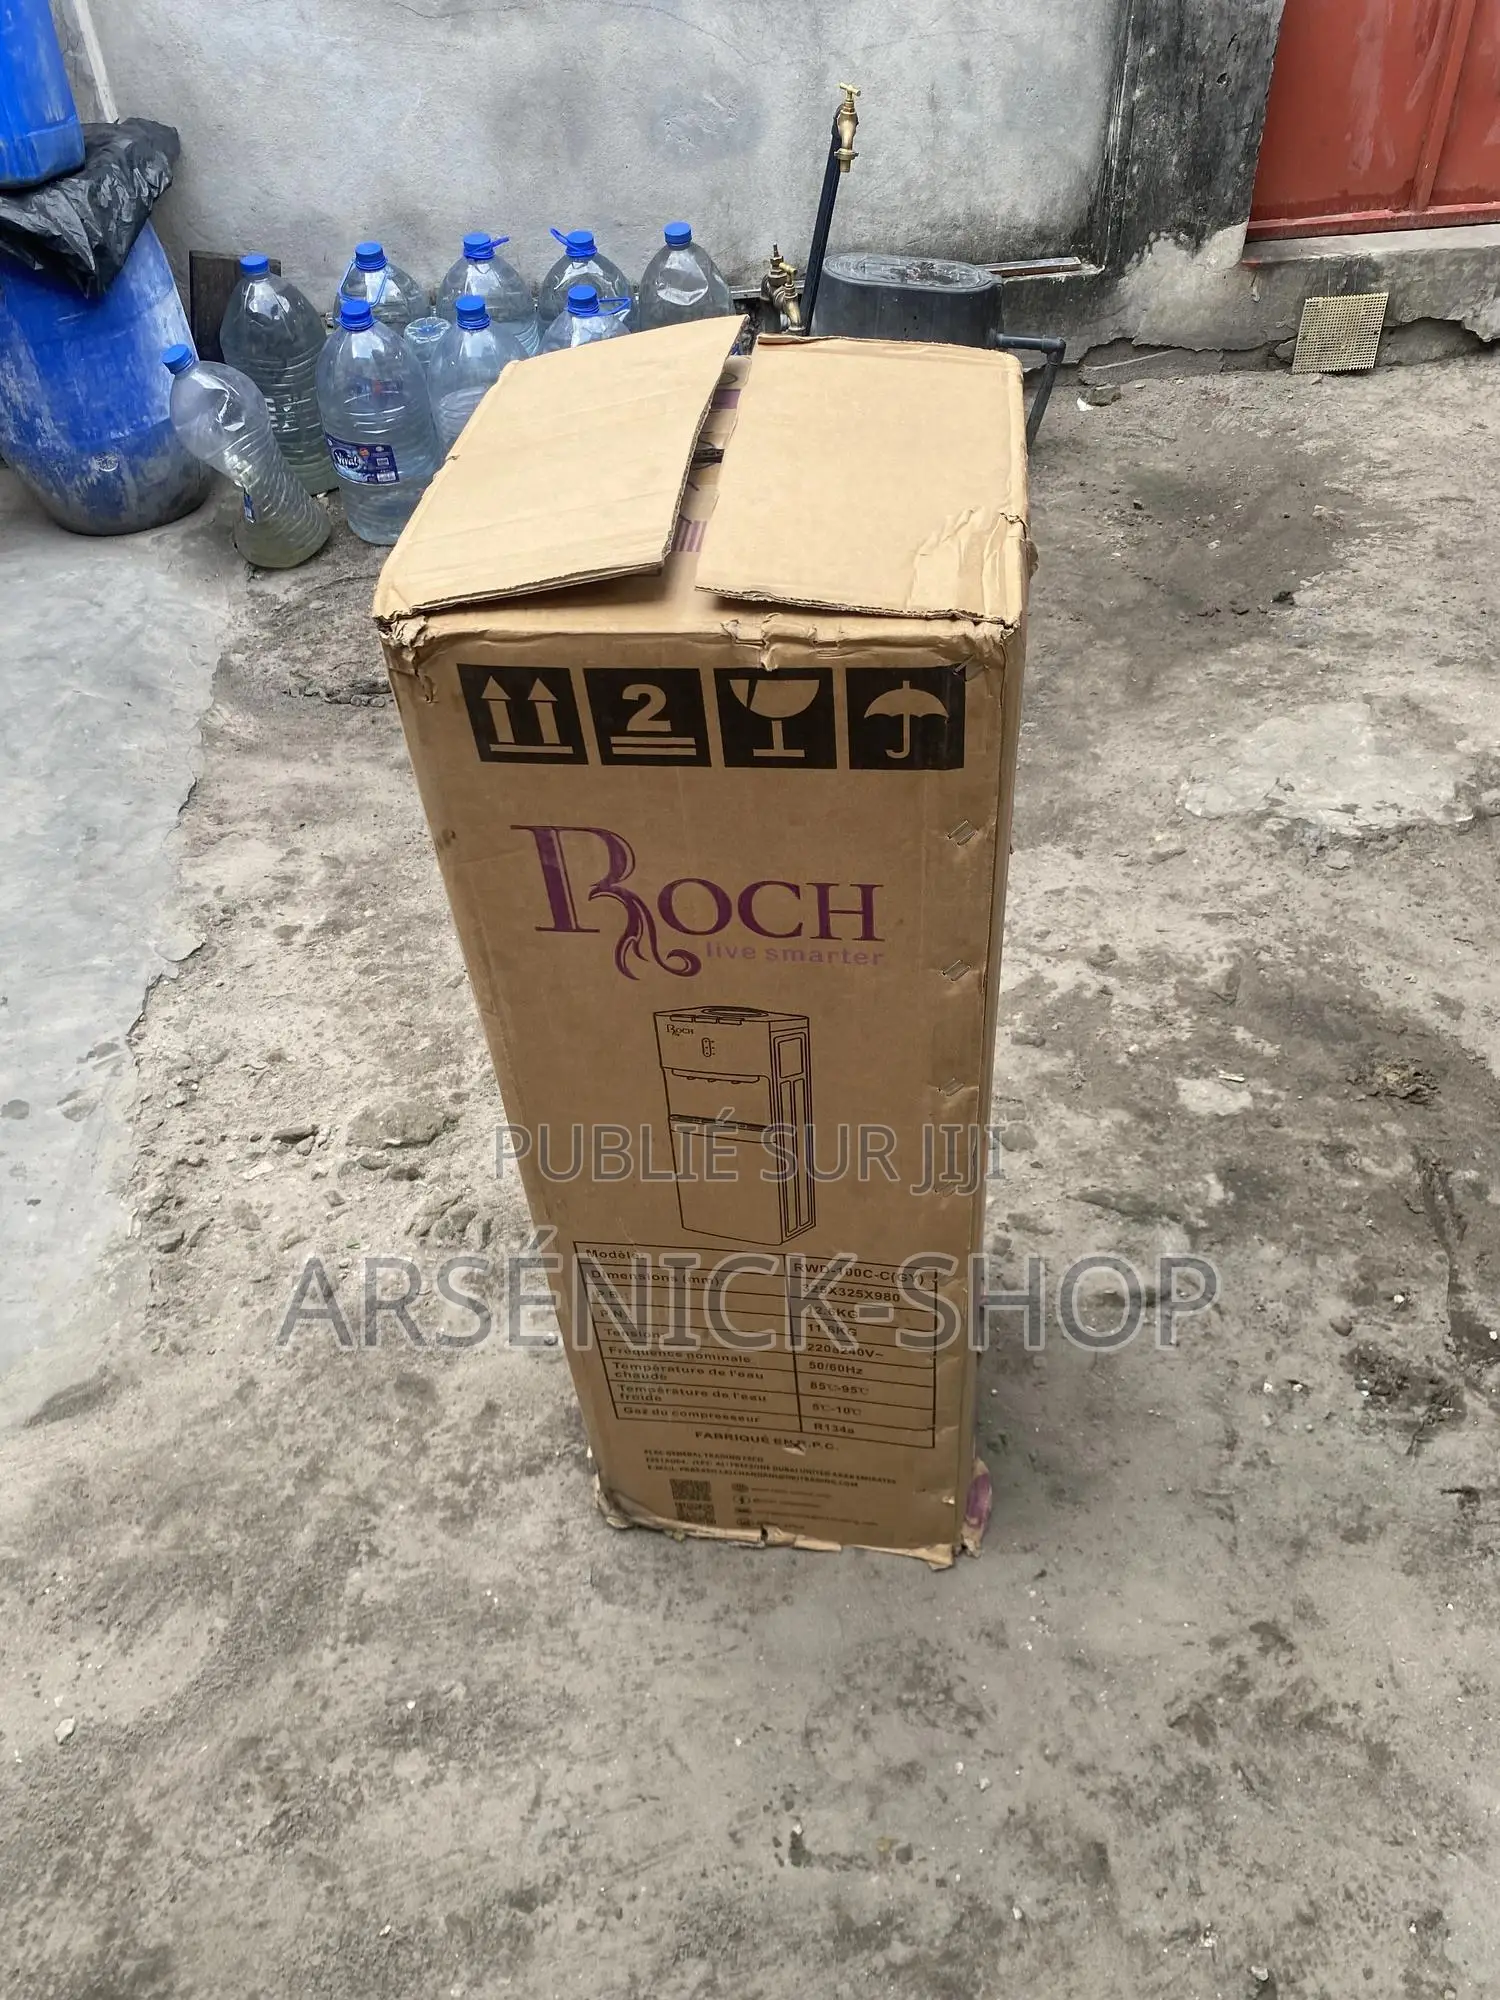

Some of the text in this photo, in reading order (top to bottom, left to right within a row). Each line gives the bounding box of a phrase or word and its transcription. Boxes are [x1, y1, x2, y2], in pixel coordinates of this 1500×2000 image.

[621, 684, 671, 732] 2
[706, 942, 885, 965] live smarter
[708, 1367, 726, 1377] de
[808, 1361, 863, 1376] 50/60Hz
[712, 1389, 730, 1399] de
[651, 1408, 668, 1417] du
[813, 1423, 855, 1435] R134a
